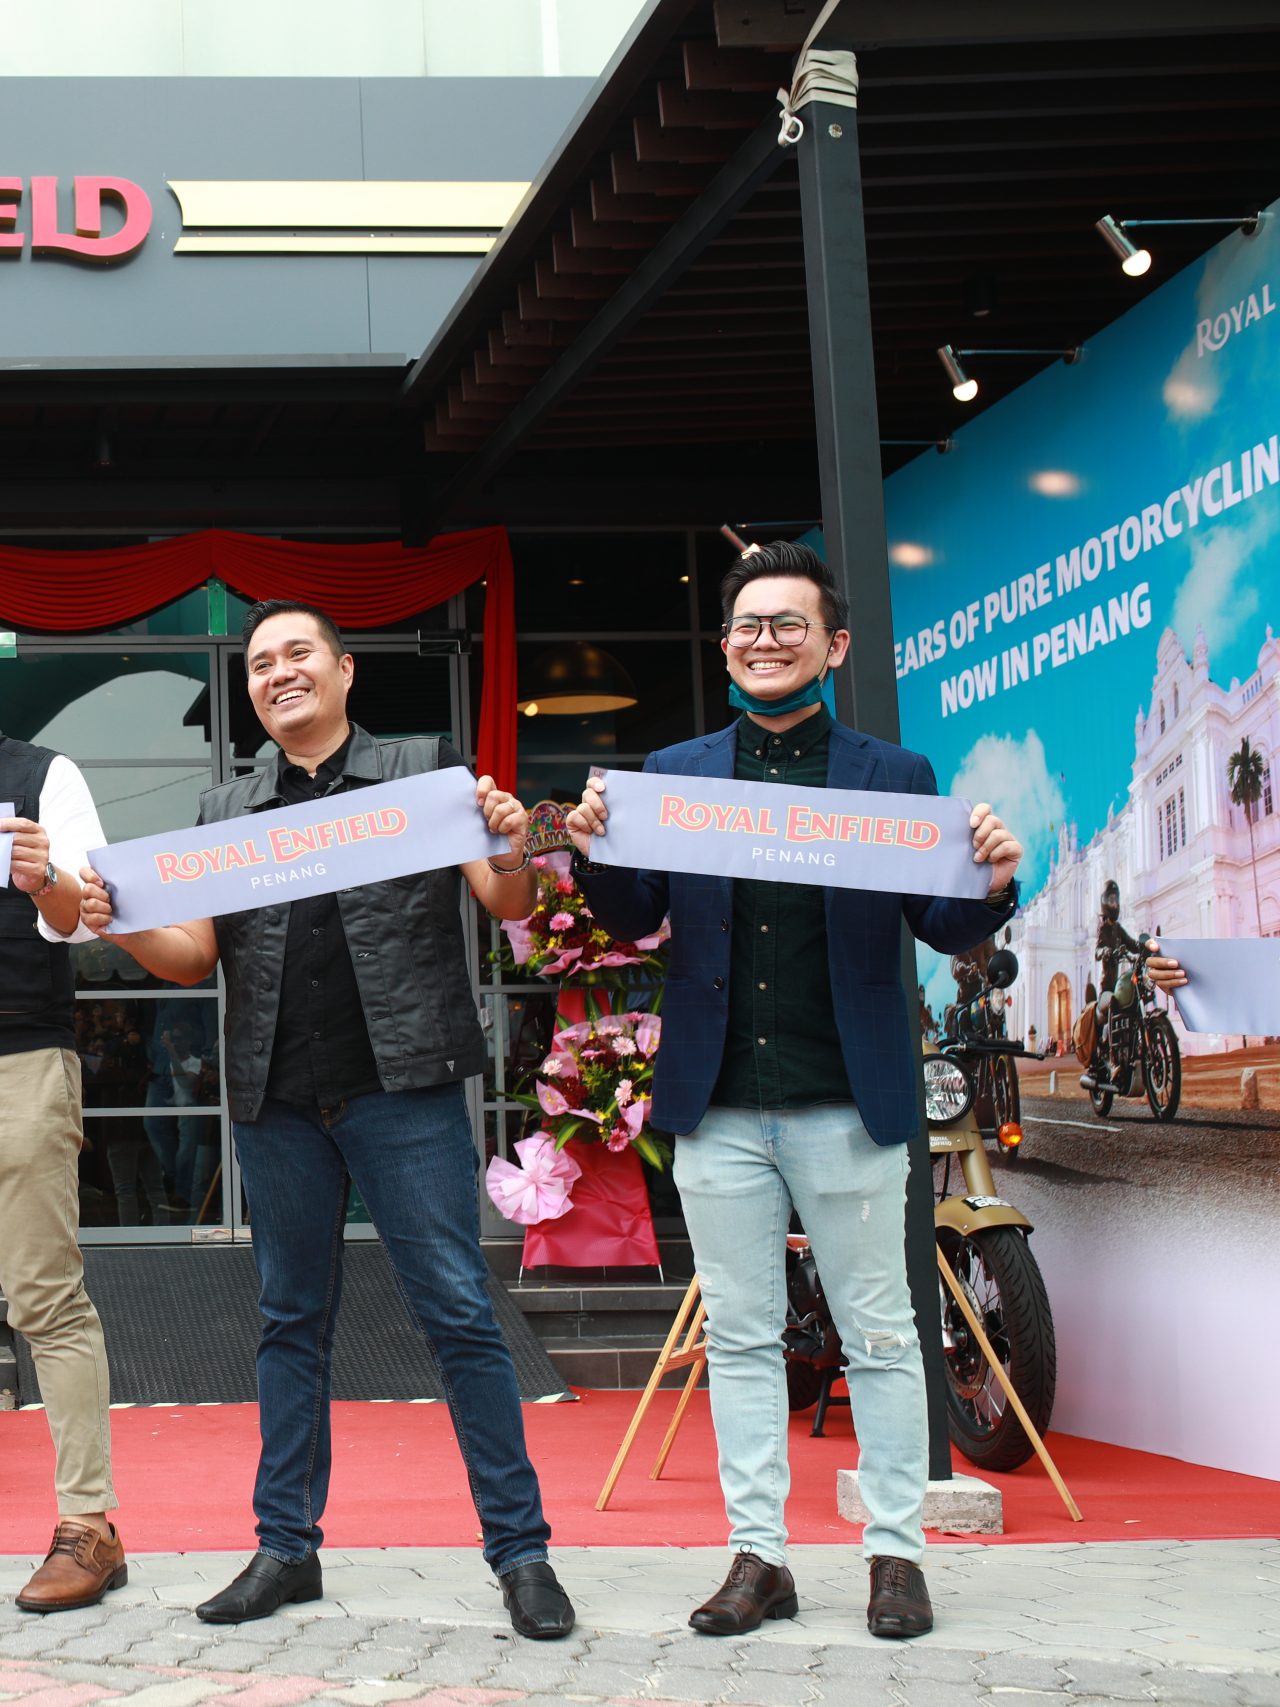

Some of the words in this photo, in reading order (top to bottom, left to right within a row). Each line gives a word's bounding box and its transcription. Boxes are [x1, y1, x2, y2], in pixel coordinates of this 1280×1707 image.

[1196, 283, 1277, 358] ROYAL
[894, 620, 947, 680] EARS
[949, 601, 980, 650] OF
[983, 562, 1053, 635] PURE
[1055, 434, 1280, 599] MOTORCYCLIN
[940, 656, 997, 718] NOW
[1002, 641, 1030, 691] IN
[1033, 582, 1152, 677] PENANG
[154, 839, 267, 884] ROYAL
[267, 807, 408, 864] ENFIELD
[659, 794, 778, 832] ROYAL
[784, 805, 941, 851] ENFIELD
[751, 847, 837, 867] PENANG
[250, 862, 328, 889] PENANG
